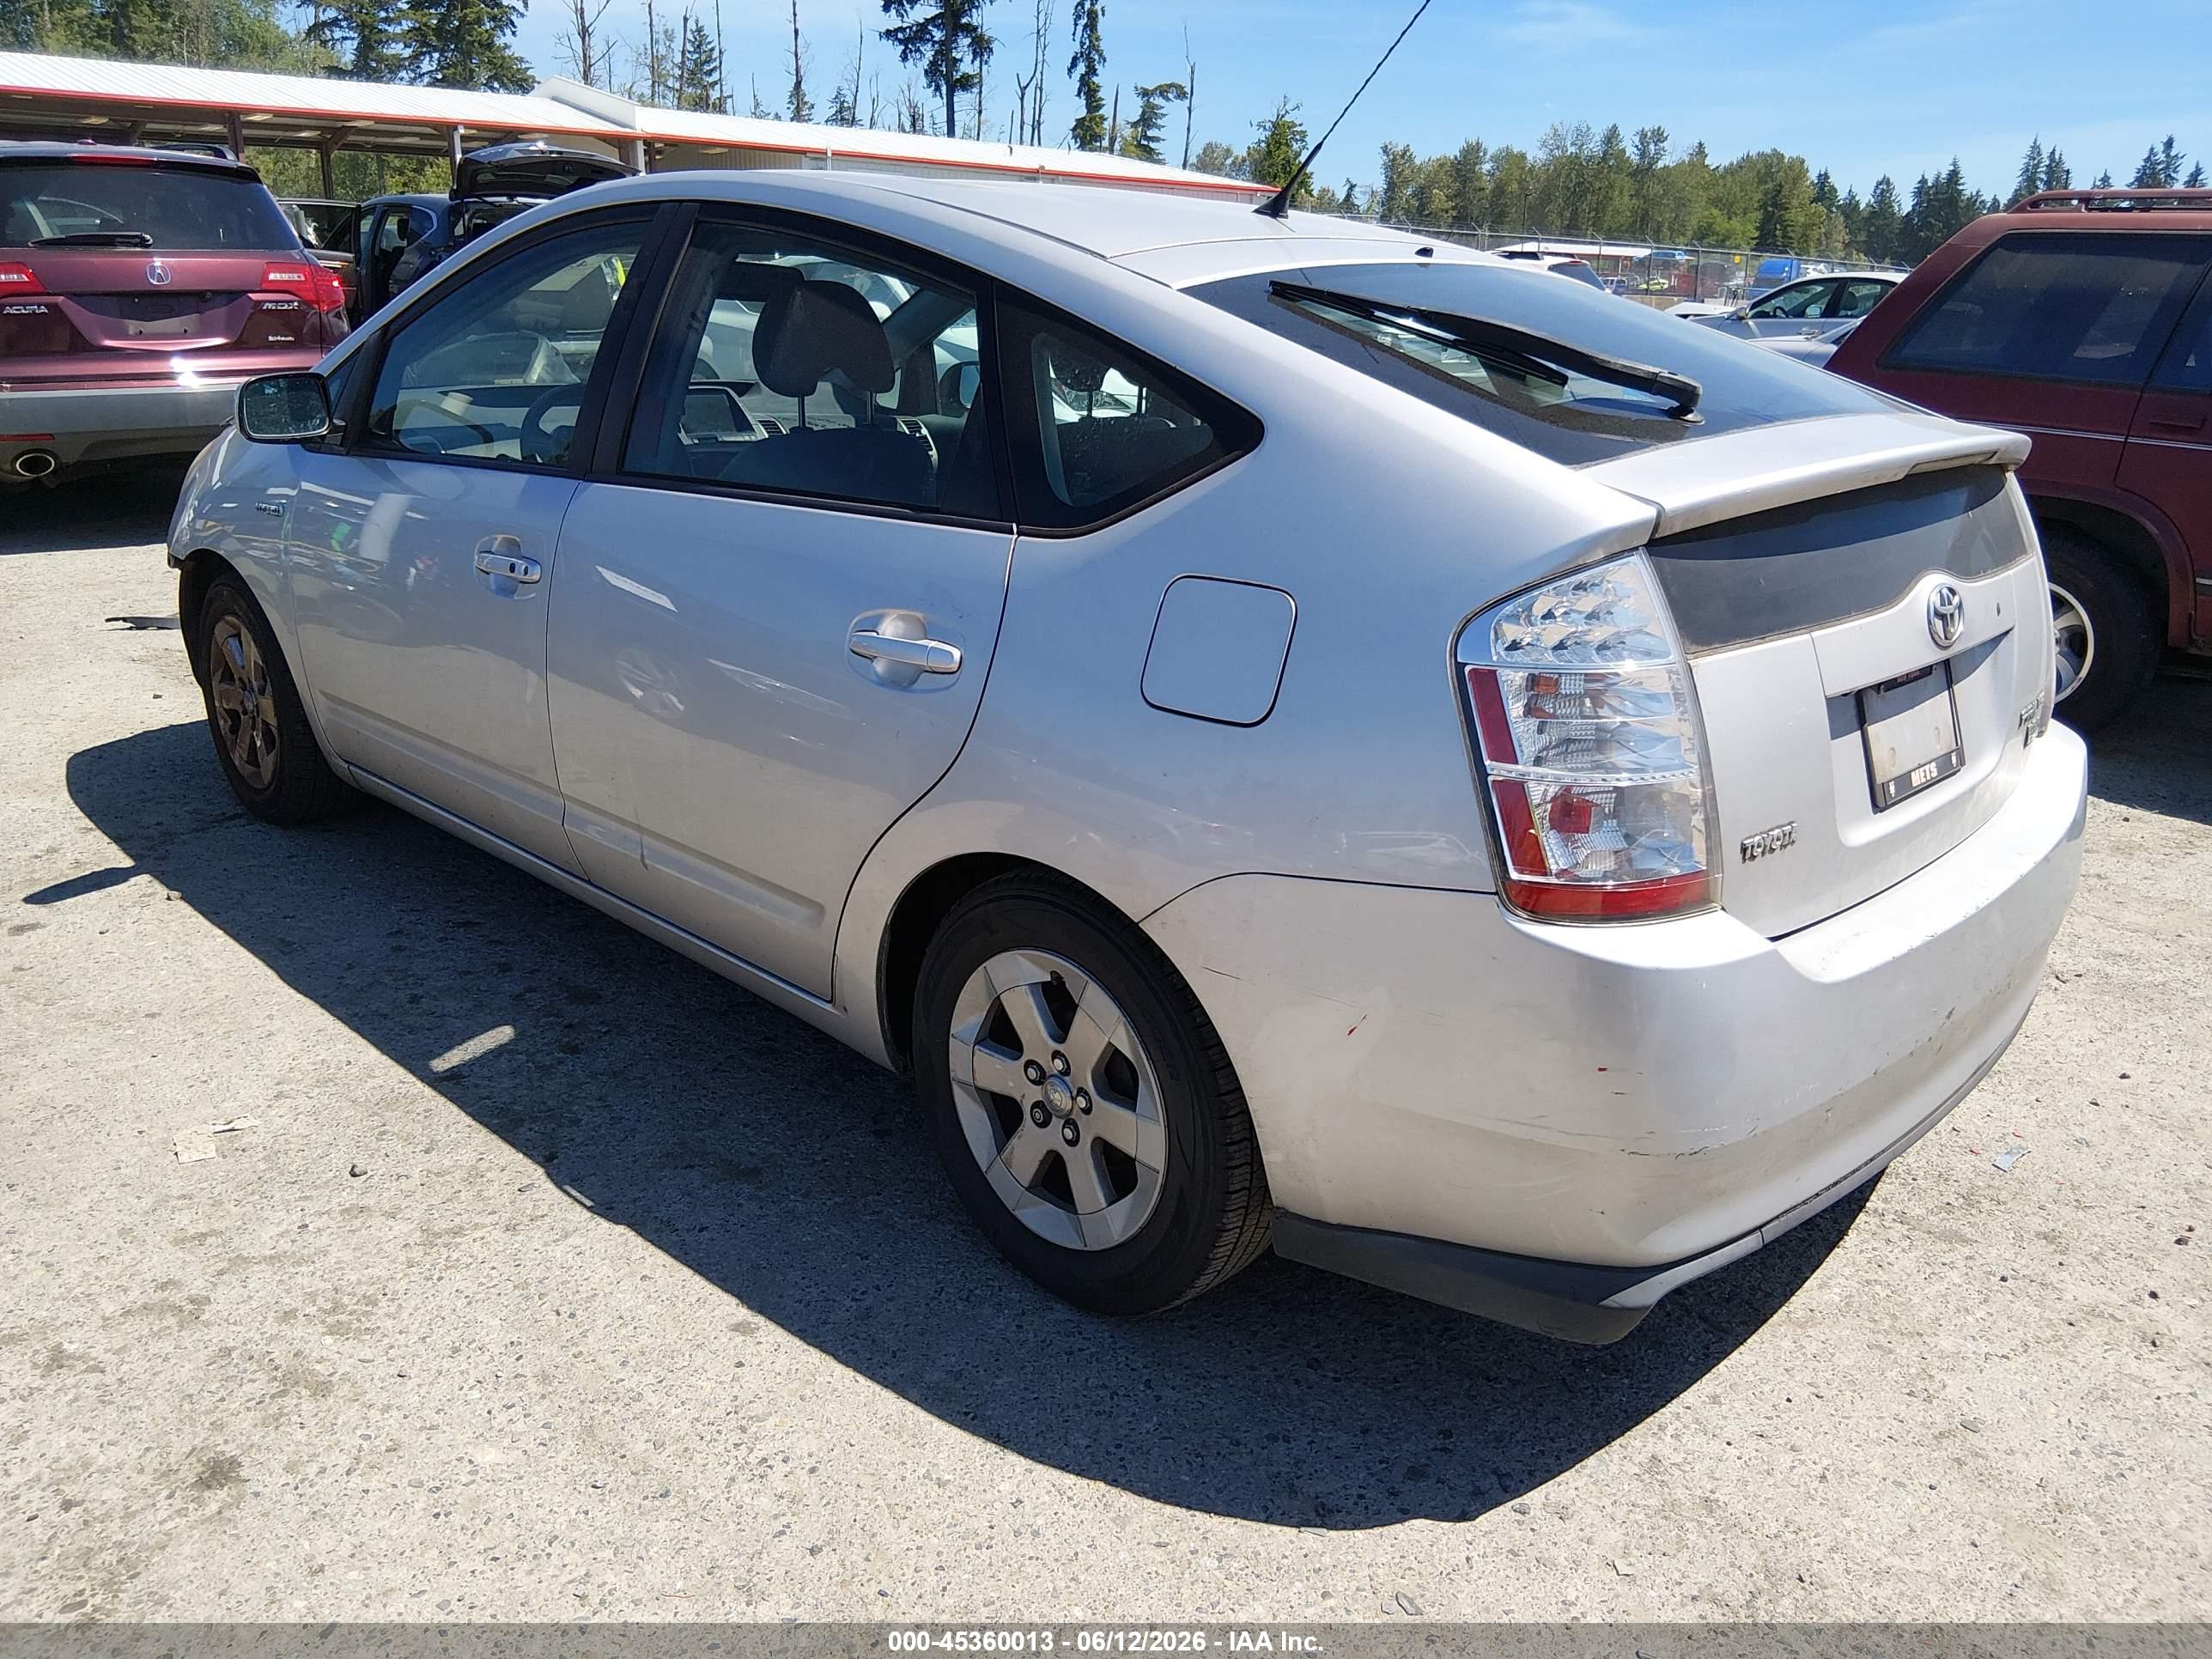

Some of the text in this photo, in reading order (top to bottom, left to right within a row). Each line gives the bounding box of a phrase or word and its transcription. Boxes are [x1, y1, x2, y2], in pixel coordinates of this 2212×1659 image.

[3, 305, 49, 314] ACURA
[261, 301, 299, 310] MDX
[1911, 761, 1938, 787] METS
